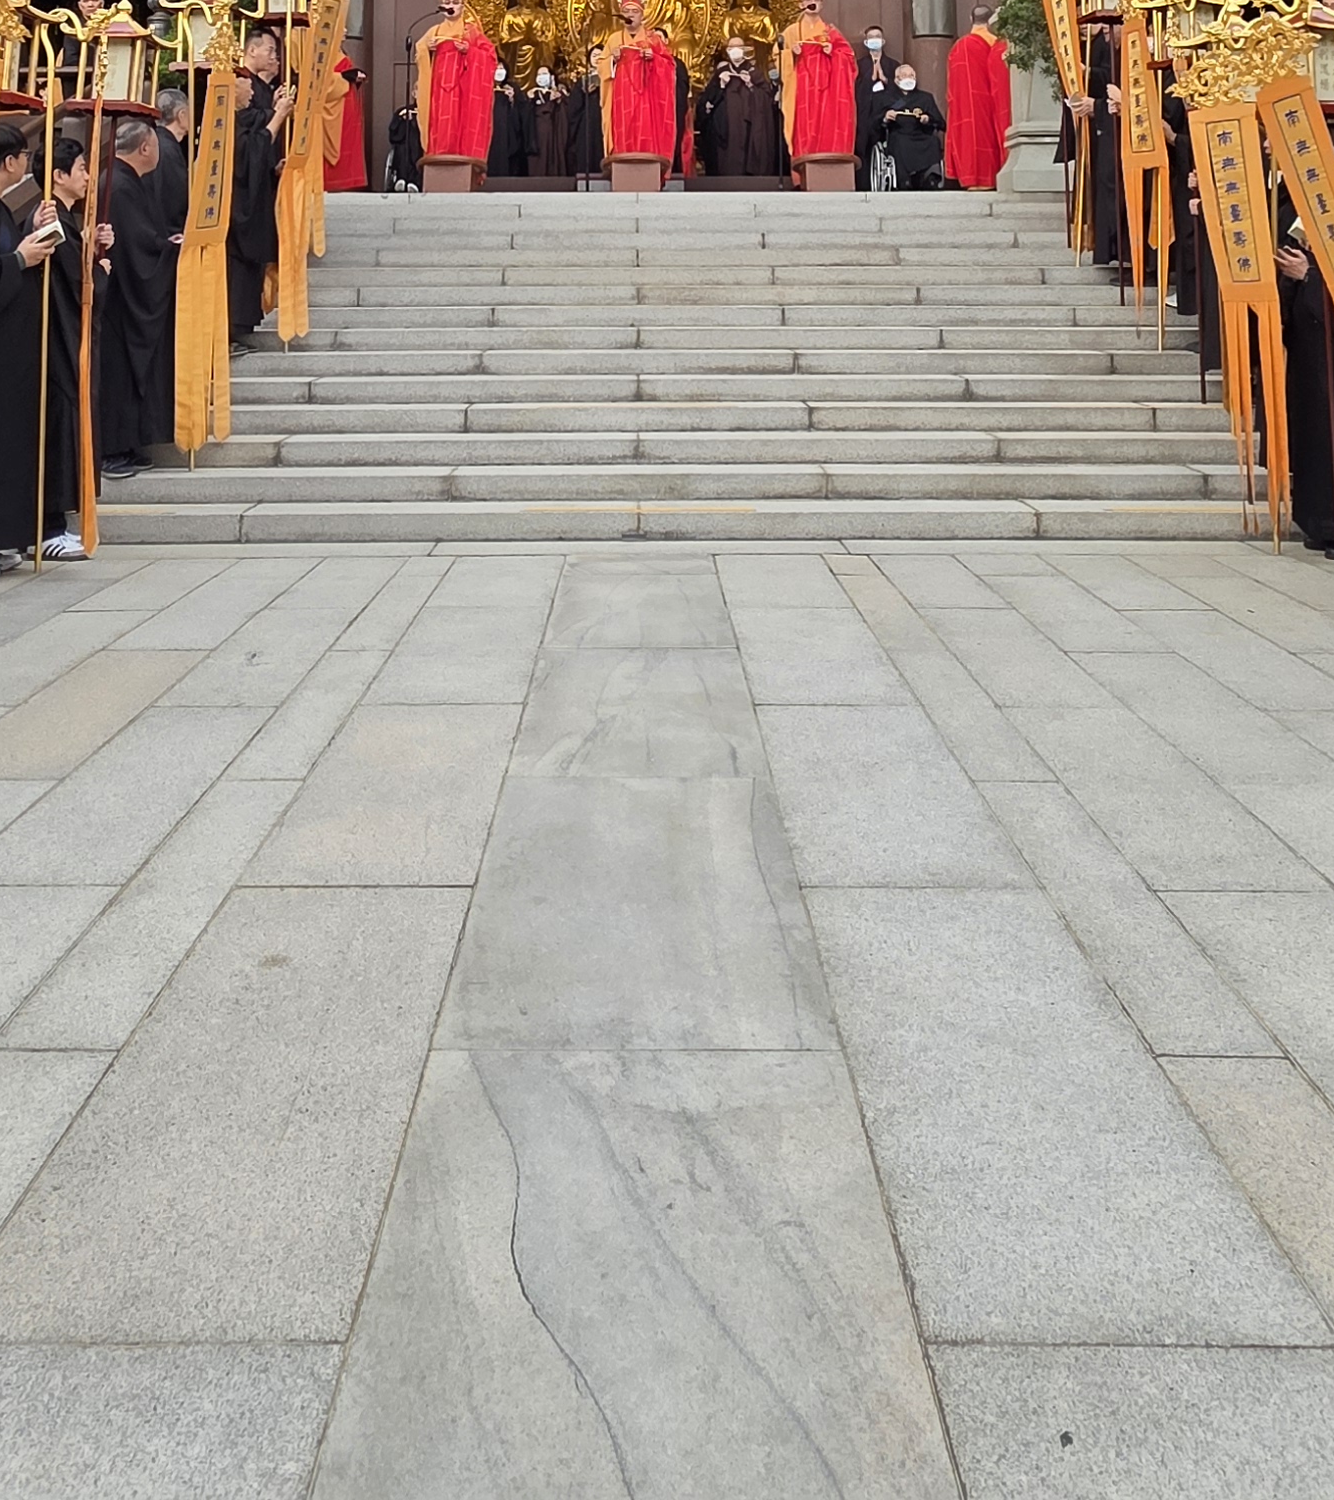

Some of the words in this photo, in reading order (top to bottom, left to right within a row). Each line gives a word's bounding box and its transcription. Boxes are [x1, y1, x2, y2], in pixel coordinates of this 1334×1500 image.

[1216, 129, 1252, 274] 南無無量壽佛
